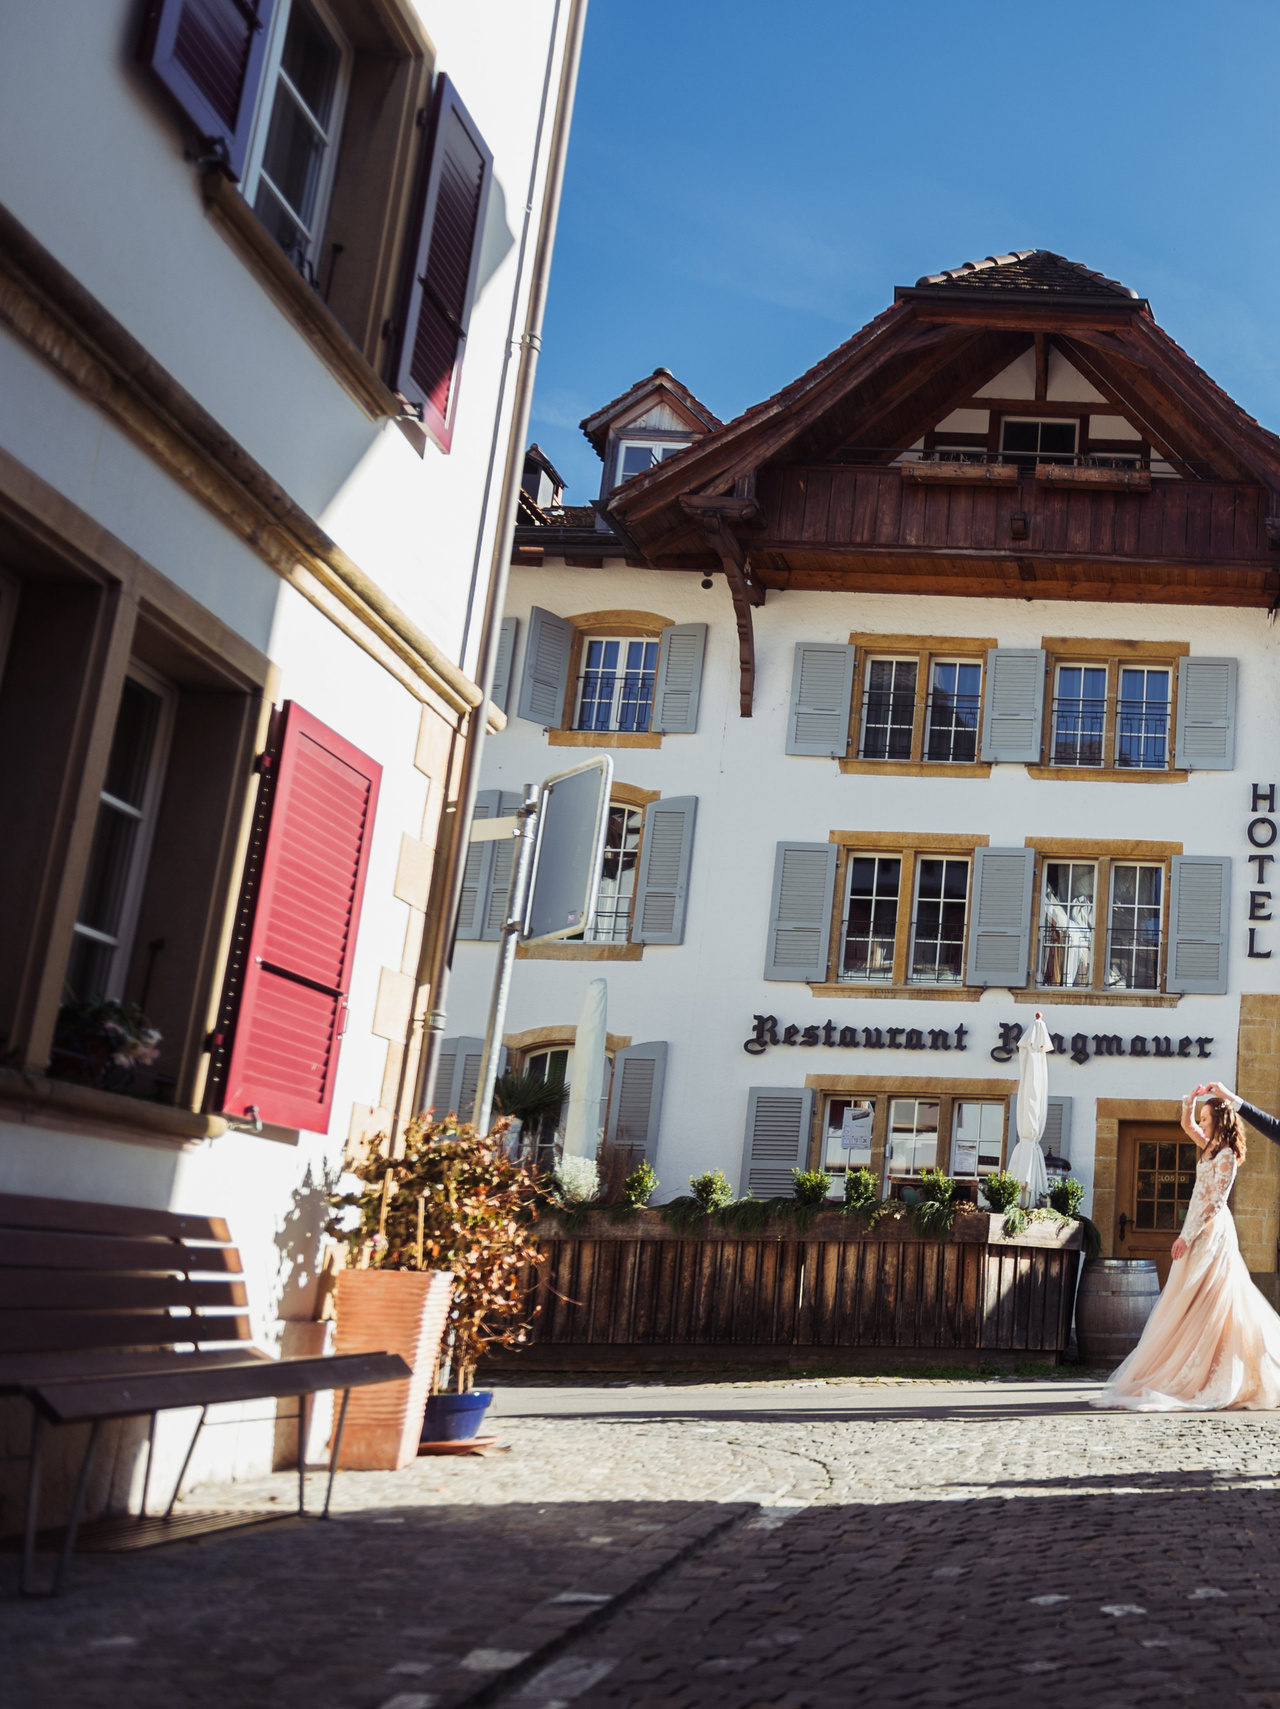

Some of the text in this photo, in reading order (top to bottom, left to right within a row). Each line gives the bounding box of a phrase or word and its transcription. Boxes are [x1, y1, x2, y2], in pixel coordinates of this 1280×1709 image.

[1247, 783, 1278, 959] HOTEL
[743, 1013, 1215, 1066] Restaurant Rngmauer
